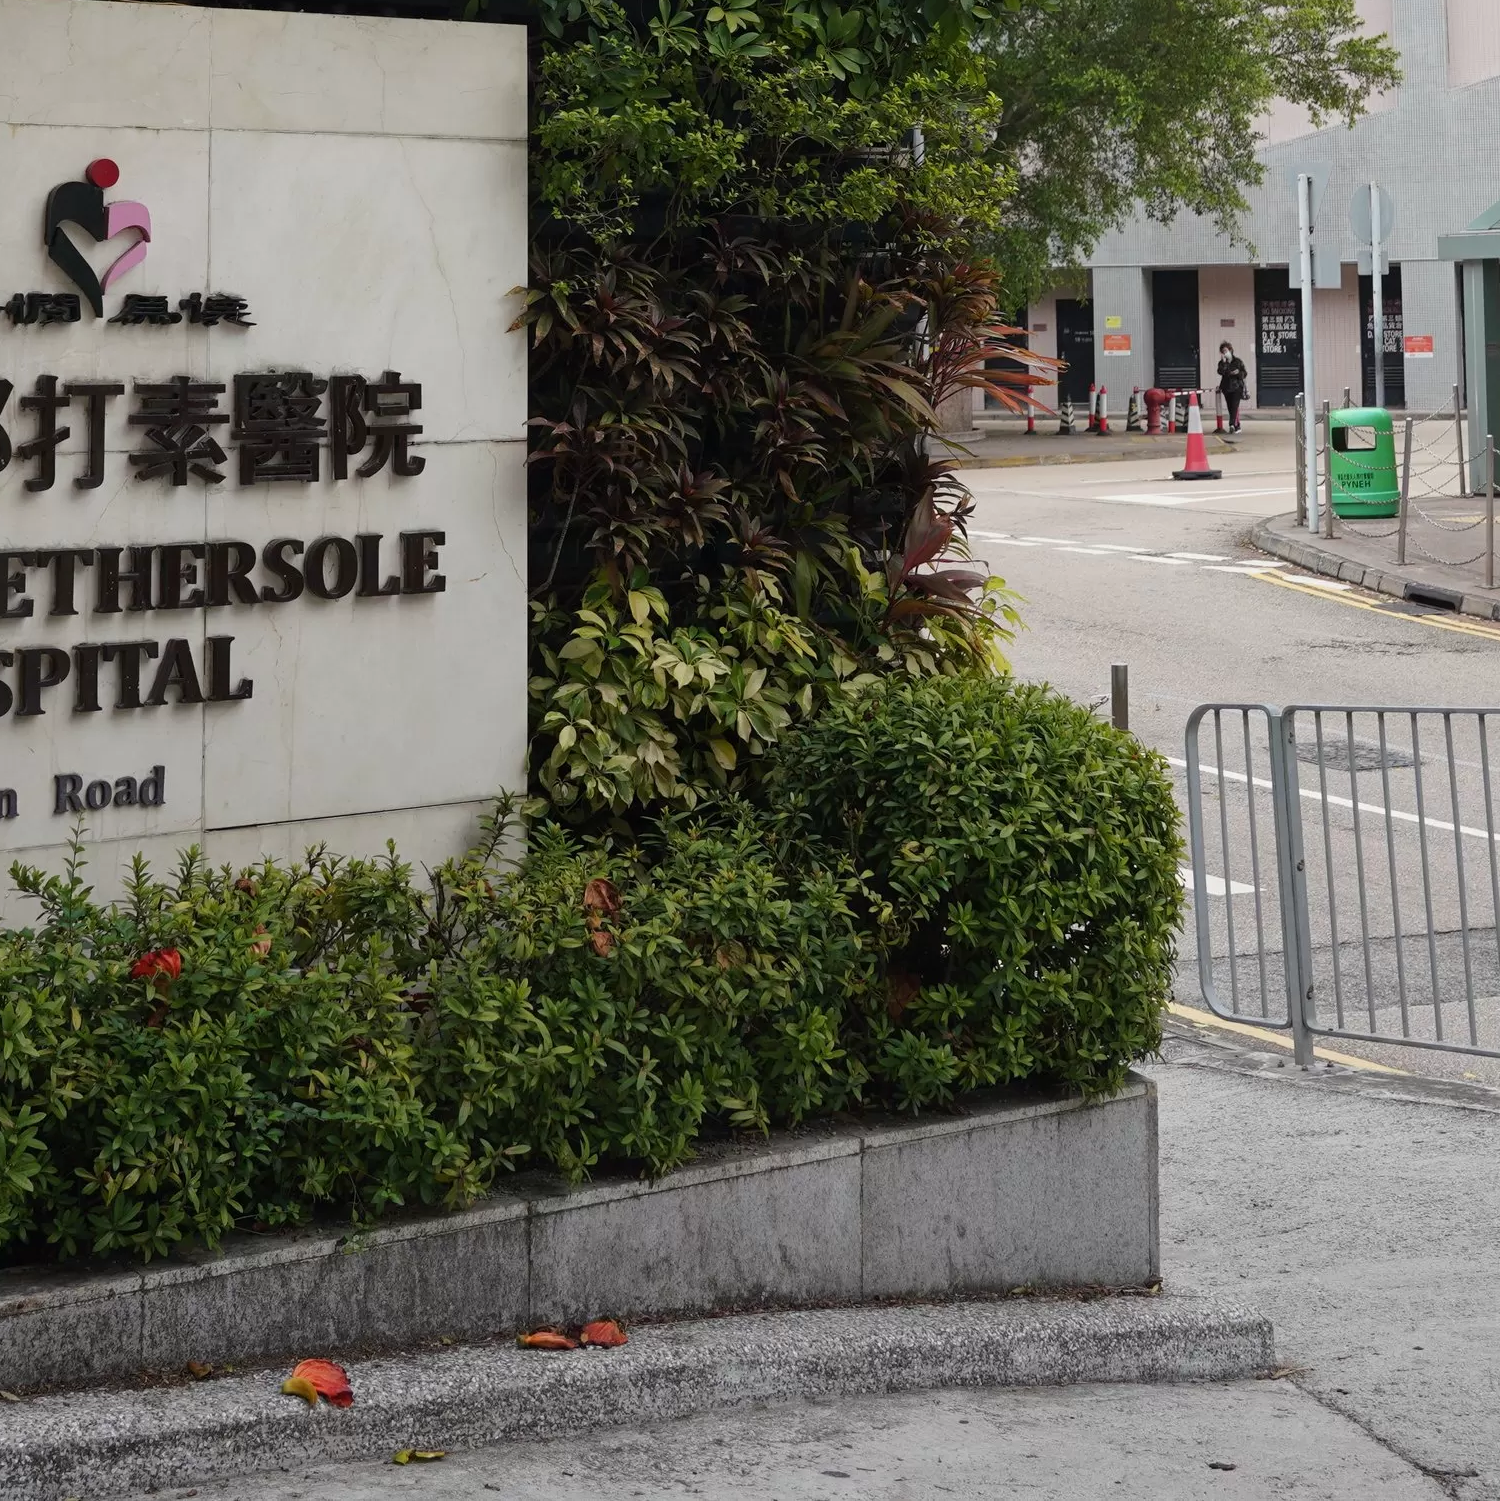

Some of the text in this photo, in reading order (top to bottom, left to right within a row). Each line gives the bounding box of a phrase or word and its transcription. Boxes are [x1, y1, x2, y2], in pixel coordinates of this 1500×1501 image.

[1277, 331, 1297, 339] STORE
[1263, 345, 1287, 353] STORE 1
[1341, 480, 1371, 488] PYNEH
[53, 764, 166, 815] Road
